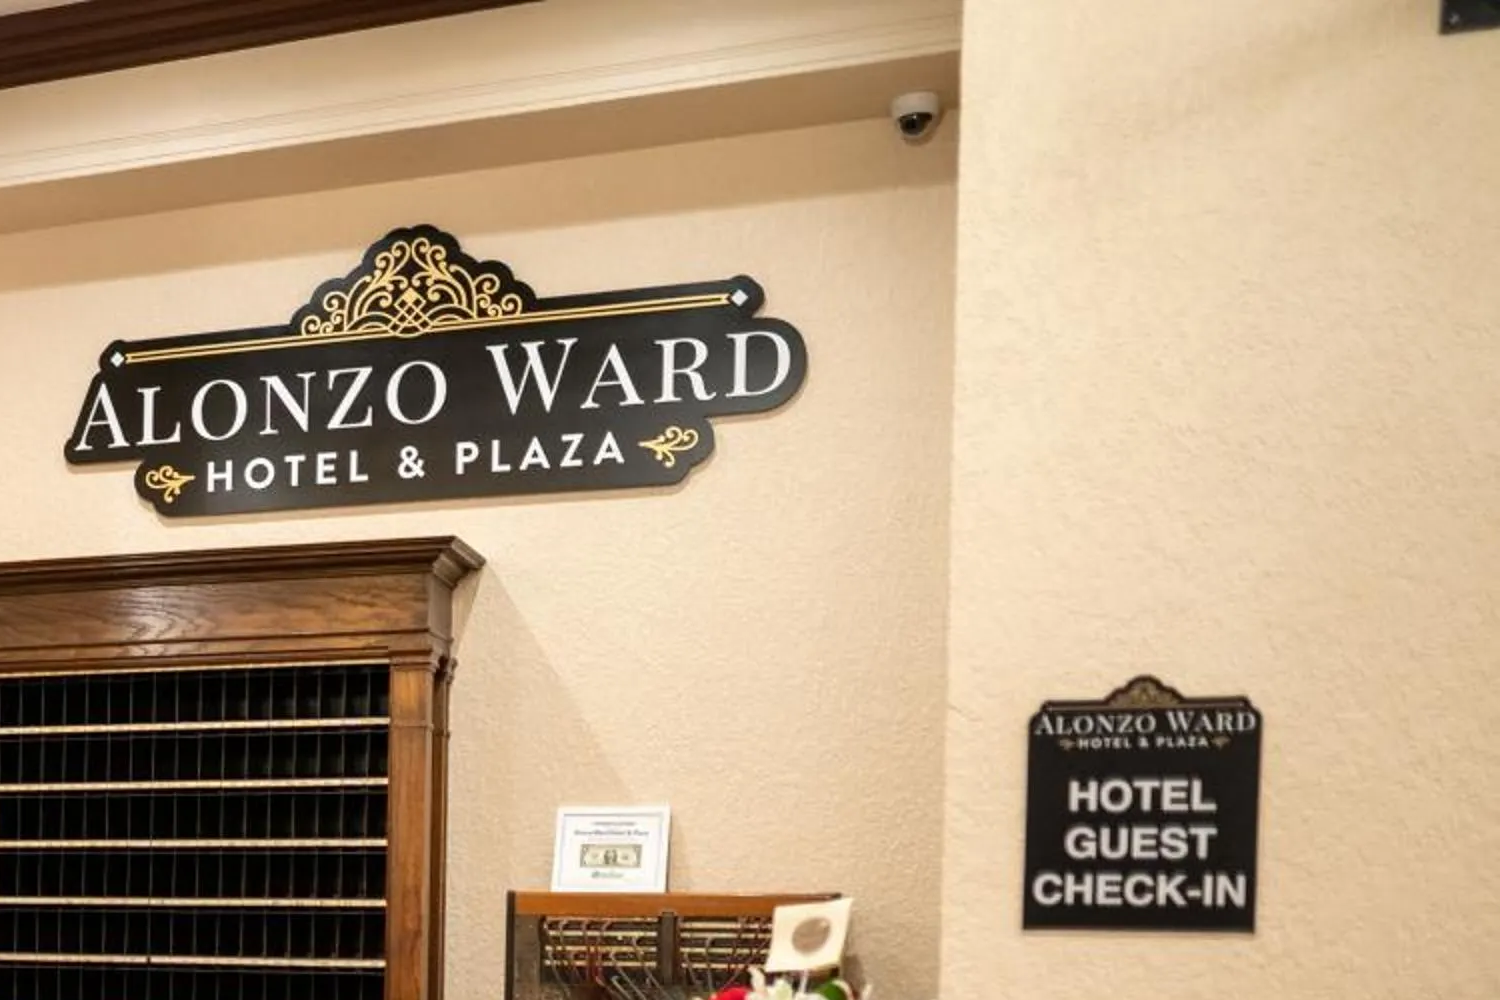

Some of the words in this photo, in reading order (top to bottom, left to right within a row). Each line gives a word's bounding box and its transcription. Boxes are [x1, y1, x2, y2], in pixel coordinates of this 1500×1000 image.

[75, 360, 448, 452] ALONZO
[486, 330, 793, 416] WARD
[206, 452, 369, 493] HOTEL
[397, 443, 426, 479] &
[455, 430, 626, 475] PLAZA
[1034, 712, 1157, 735] ALONZO
[1166, 710, 1257, 732] WARD
[1078, 737, 1132, 749] HOTEL
[1139, 736, 1149, 749] &
[1155, 736, 1209, 748] PLAZA
[1068, 779, 1218, 813] HOTEL
[1063, 826, 1218, 861] GUEST
[1032, 873, 1247, 908] CHECK-IN
